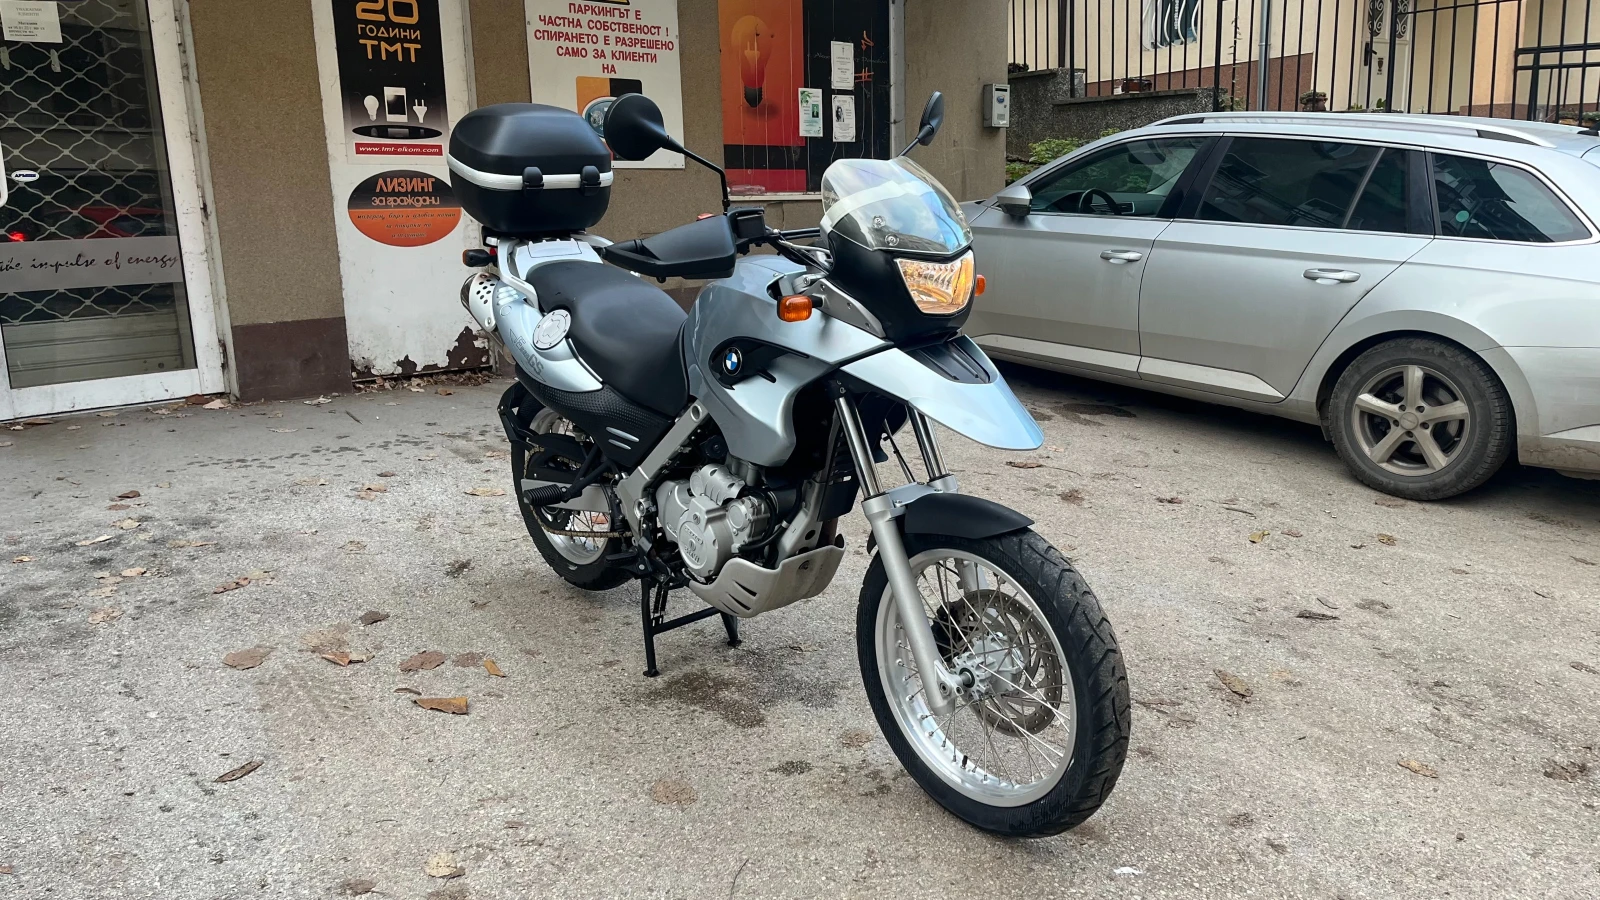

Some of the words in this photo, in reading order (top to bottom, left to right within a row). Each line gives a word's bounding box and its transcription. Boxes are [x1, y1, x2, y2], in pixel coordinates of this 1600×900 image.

[355, 0, 419, 24] 20
[568, 2, 631, 19] ПАРКИНГЪТ
[635, 10, 642, 21] Е
[357, 24, 421, 40] ГОДИНИ
[538, 14, 583, 29] ЧАСТНА
[587, 19, 662, 36] СОБСТВЕНОСТ
[533, 29, 599, 45] СПИРАНЕТО
[604, 35, 611, 46] Е
[615, 36, 675, 51] РАЗРЕШЕНО
[358, 39, 422, 63] ТМТ
[556, 45, 588, 58] САМО
[592, 48, 607, 60] ЗА
[611, 50, 658, 63] КЛИЕНТИ
[602, 63, 617, 75] НА
[376, 178, 435, 192] ЛИЗИНГ
[371, 196, 386, 206] за
[387, 194, 440, 208] граждани
[30, 253, 96, 273] impulse
[104, 251, 120, 270] of
[127, 254, 179, 269] energy
